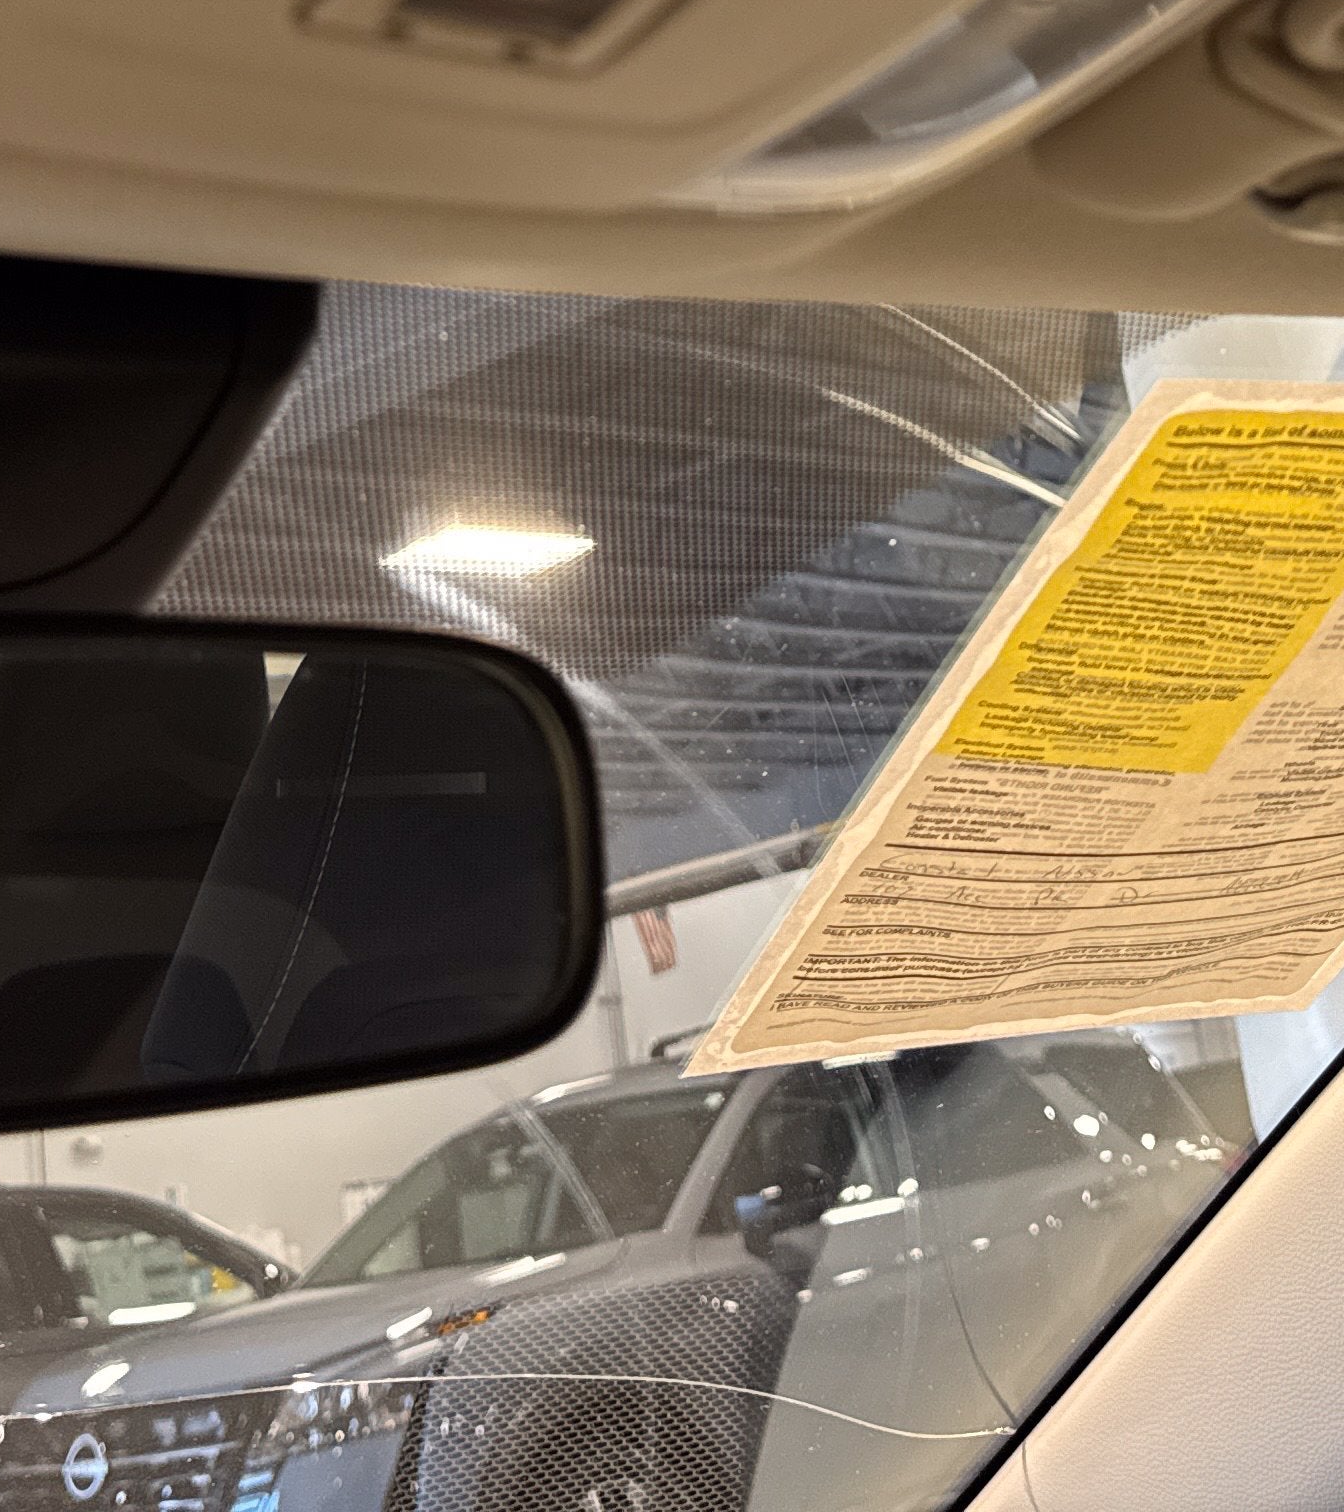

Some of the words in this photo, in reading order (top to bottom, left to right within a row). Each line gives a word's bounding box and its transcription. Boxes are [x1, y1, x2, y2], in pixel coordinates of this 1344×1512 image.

[1173, 425, 1224, 437] Below
[1227, 426, 1245, 438] is
[1261, 426, 1284, 438] list
[1286, 425, 1307, 437] of
[969, 787, 1009, 797] leakage
[915, 815, 953, 824] Gauges
[1012, 822, 1050, 831] devices
[928, 825, 986, 833] conditioner
[906, 831, 939, 839] Heater
[860, 870, 910, 880] DEALER
[842, 896, 898, 905] ADDRESS
[876, 929, 951, 937] COMPLAINTS
[803, 956, 881, 964] IMPORTANT:
[910, 956, 980, 966] information
[798, 965, 838, 974] before
[842, 964, 902, 973] consumer
[903, 965, 960, 973] purchase
[814, 1000, 850, 1009] READ
